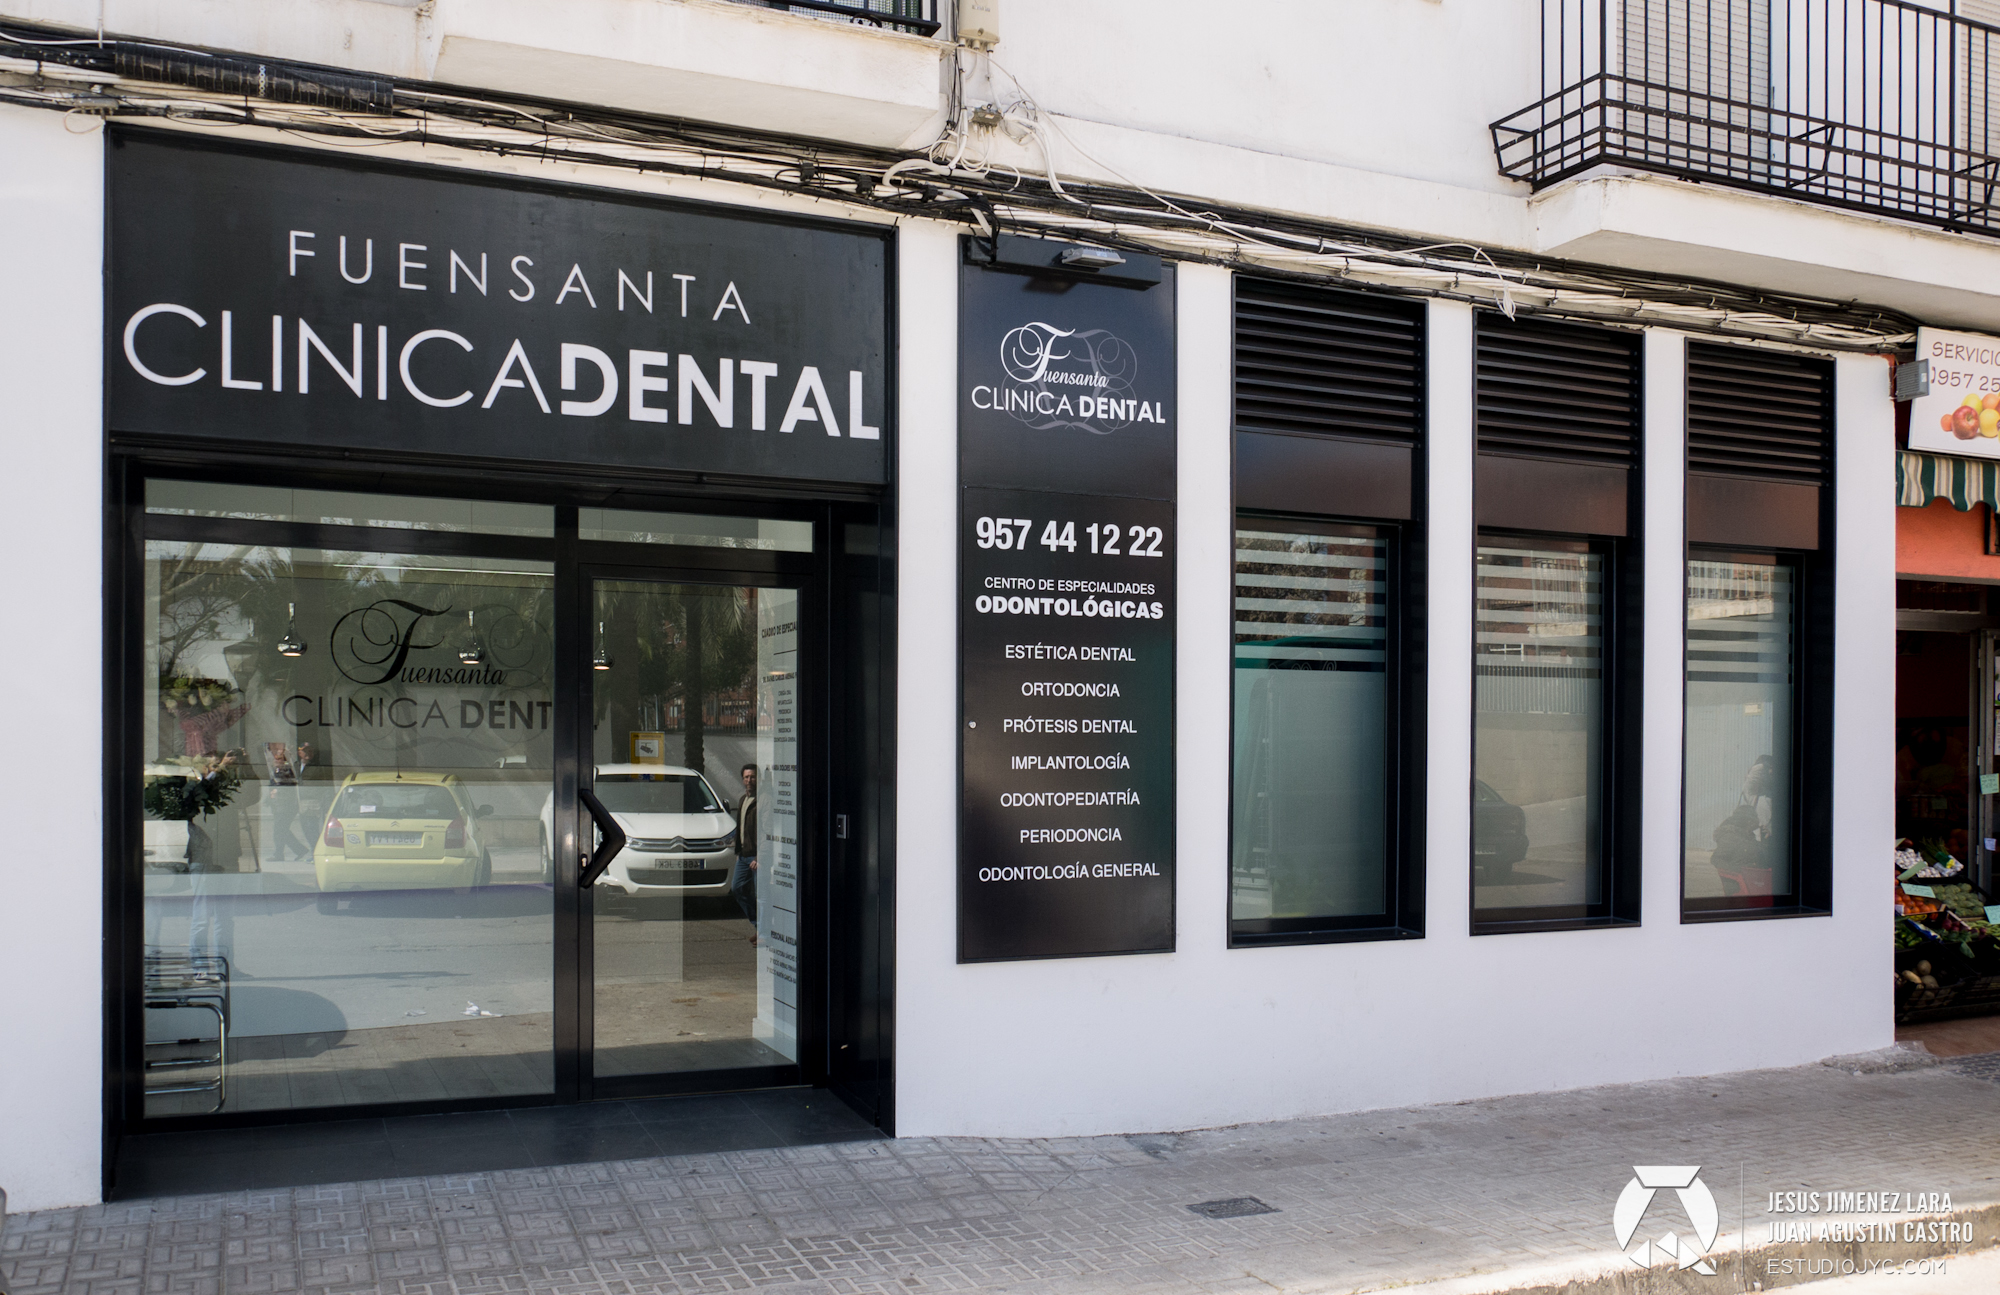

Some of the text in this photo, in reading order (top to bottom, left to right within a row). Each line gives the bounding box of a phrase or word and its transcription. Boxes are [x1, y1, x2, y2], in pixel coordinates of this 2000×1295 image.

[290, 231, 751, 325] FUENSANTA
[1001, 321, 1110, 388] Fuensanta
[1937, 369, 1974, 388] 957
[971, 385, 1166, 424] CLINICA DENTAL
[975, 516, 1164, 558] 957 44 12 22
[984, 577, 1156, 595] CENTRO DE ESPECIALIDADES
[975, 595, 1164, 619] ODONTOLÓGICAS
[330, 599, 508, 686] Fuensanta
[1005, 642, 1136, 662] ESTÉTICA DENTAL
[1021, 682, 1121, 698] ORTODONCIA
[281, 695, 450, 729] CLINICA
[1003, 716, 1138, 734] PRÓTESIS DENTAL
[1011, 752, 1131, 770] IMPLANTOLOGÍA
[1000, 788, 1141, 807] ODONTOPEDIATRÍA
[1020, 828, 1123, 844] PERIODONCIA
[978, 861, 1161, 882] ODONTOLOGÍA GENERAL
